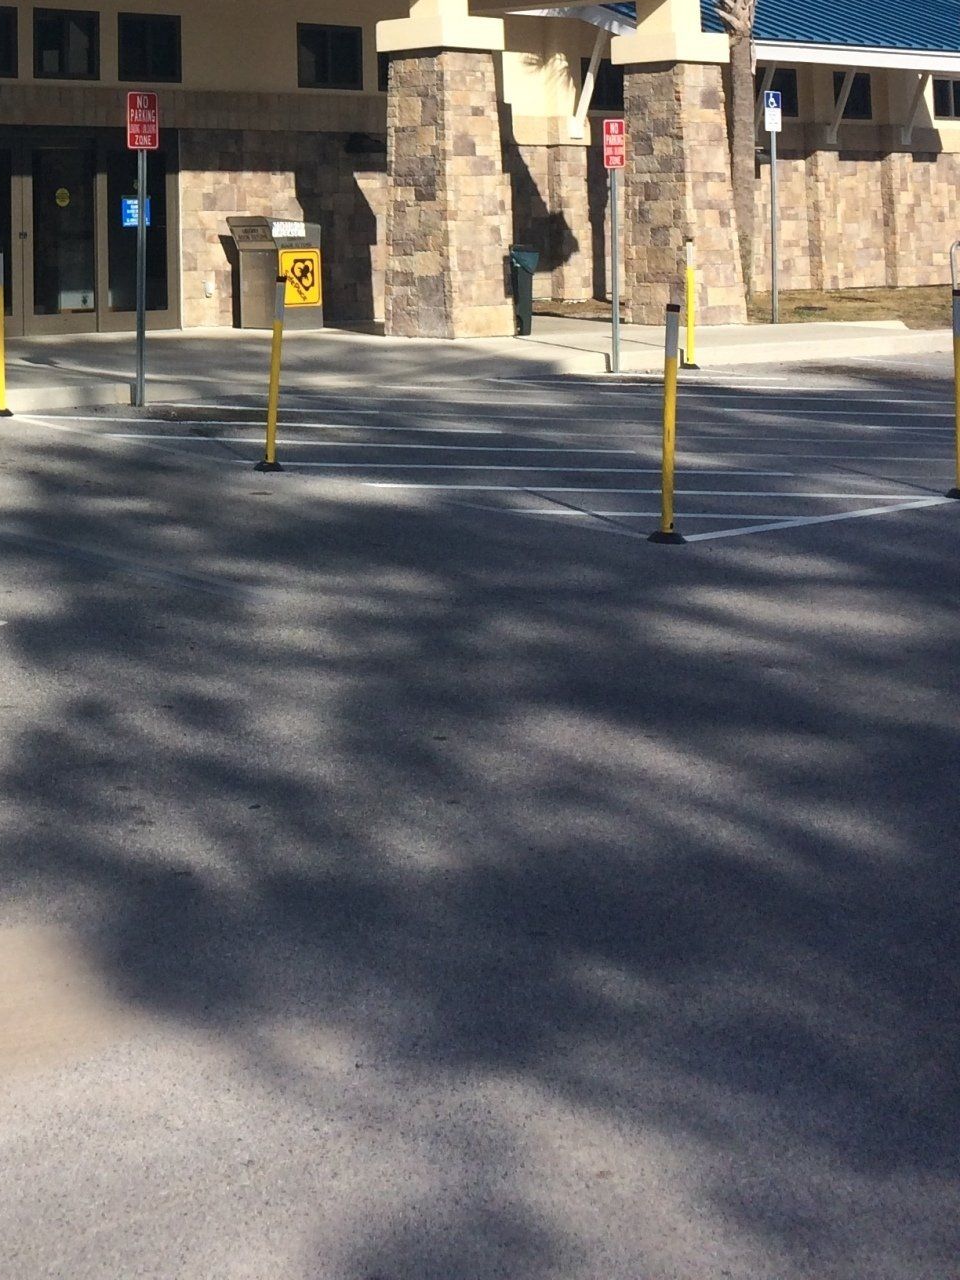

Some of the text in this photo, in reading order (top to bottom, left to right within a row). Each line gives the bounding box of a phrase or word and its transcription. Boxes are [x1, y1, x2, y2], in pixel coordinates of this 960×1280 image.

[136, 95, 149, 109] NO
[130, 108, 156, 122] PARKING
[610, 122, 619, 135] NO
[134, 134, 152, 146] ZONE
